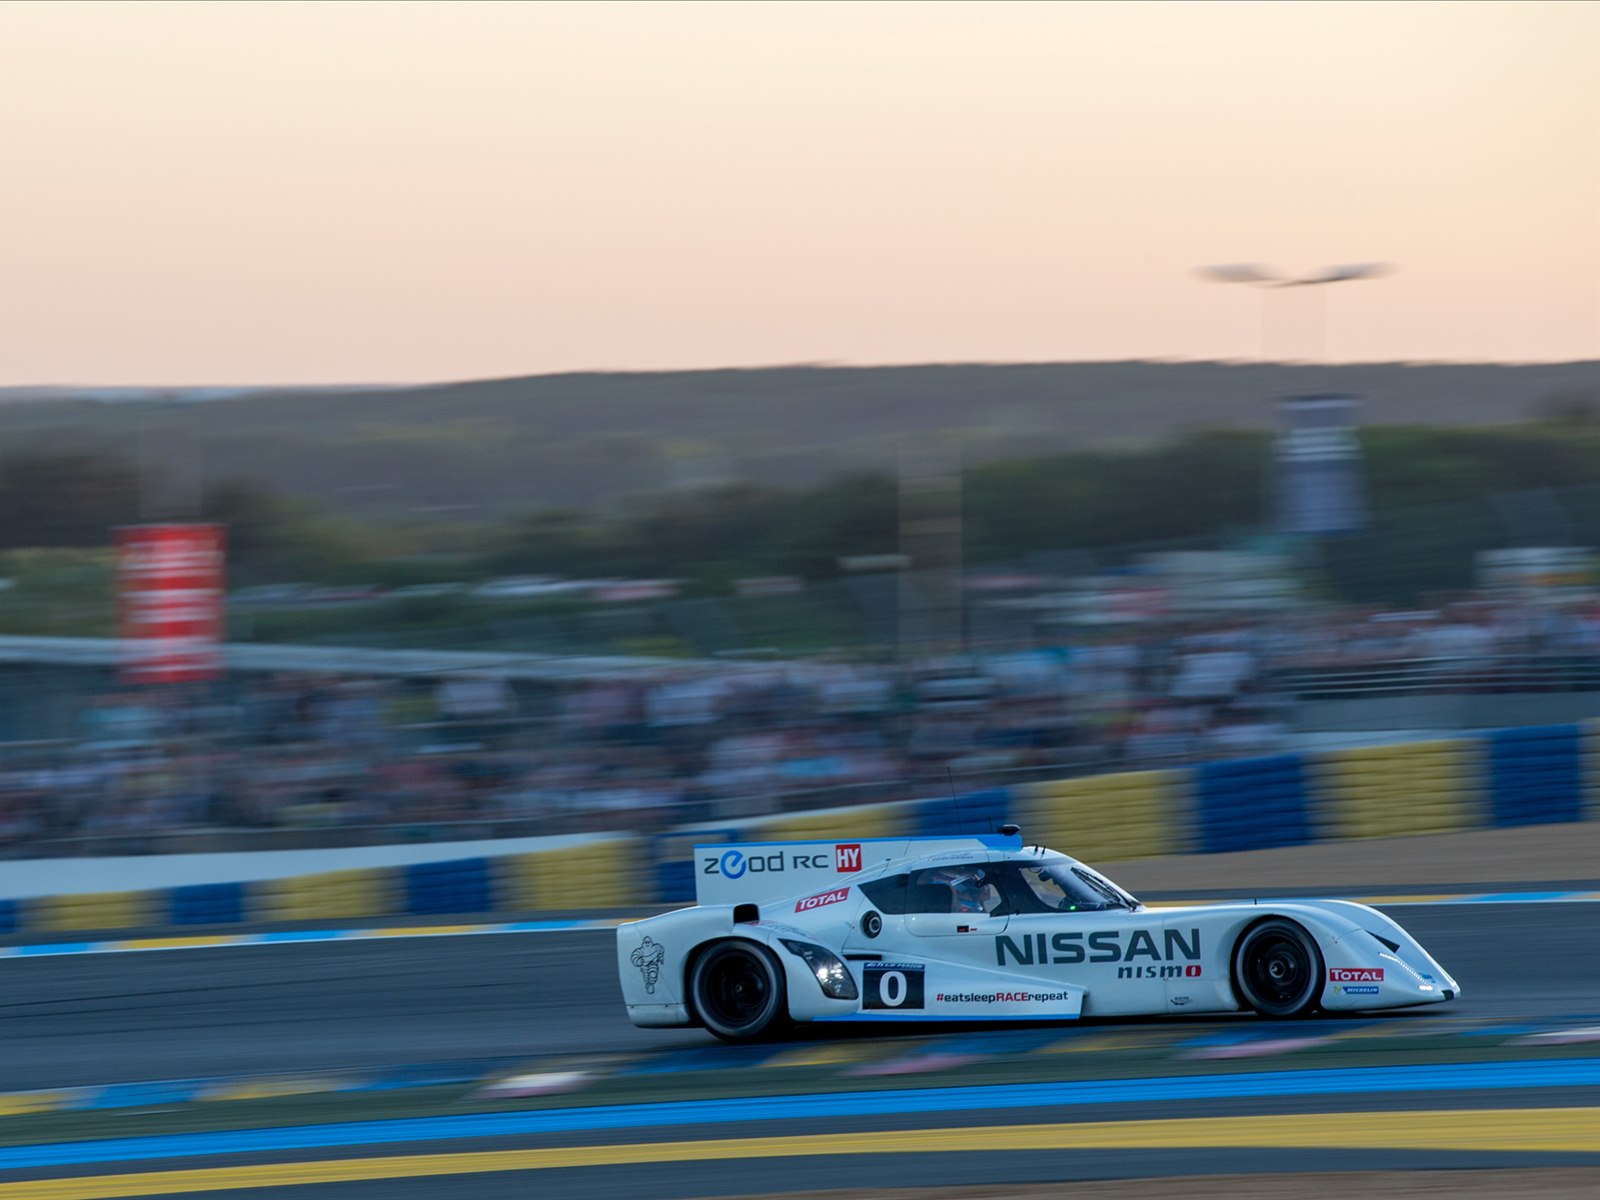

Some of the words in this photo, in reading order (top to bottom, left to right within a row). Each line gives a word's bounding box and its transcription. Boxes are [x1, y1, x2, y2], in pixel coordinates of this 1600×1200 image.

[793, 854, 829, 869] RC
[836, 848, 860, 868] HY
[799, 890, 846, 910] TOTAL
[995, 928, 1201, 966] NISSAN
[1117, 964, 1202, 979] nismo
[1331, 969, 1382, 981] TOTAL
[879, 970, 907, 1007] 0
[936, 991, 1069, 1004] #eatsleepRACErepeat
